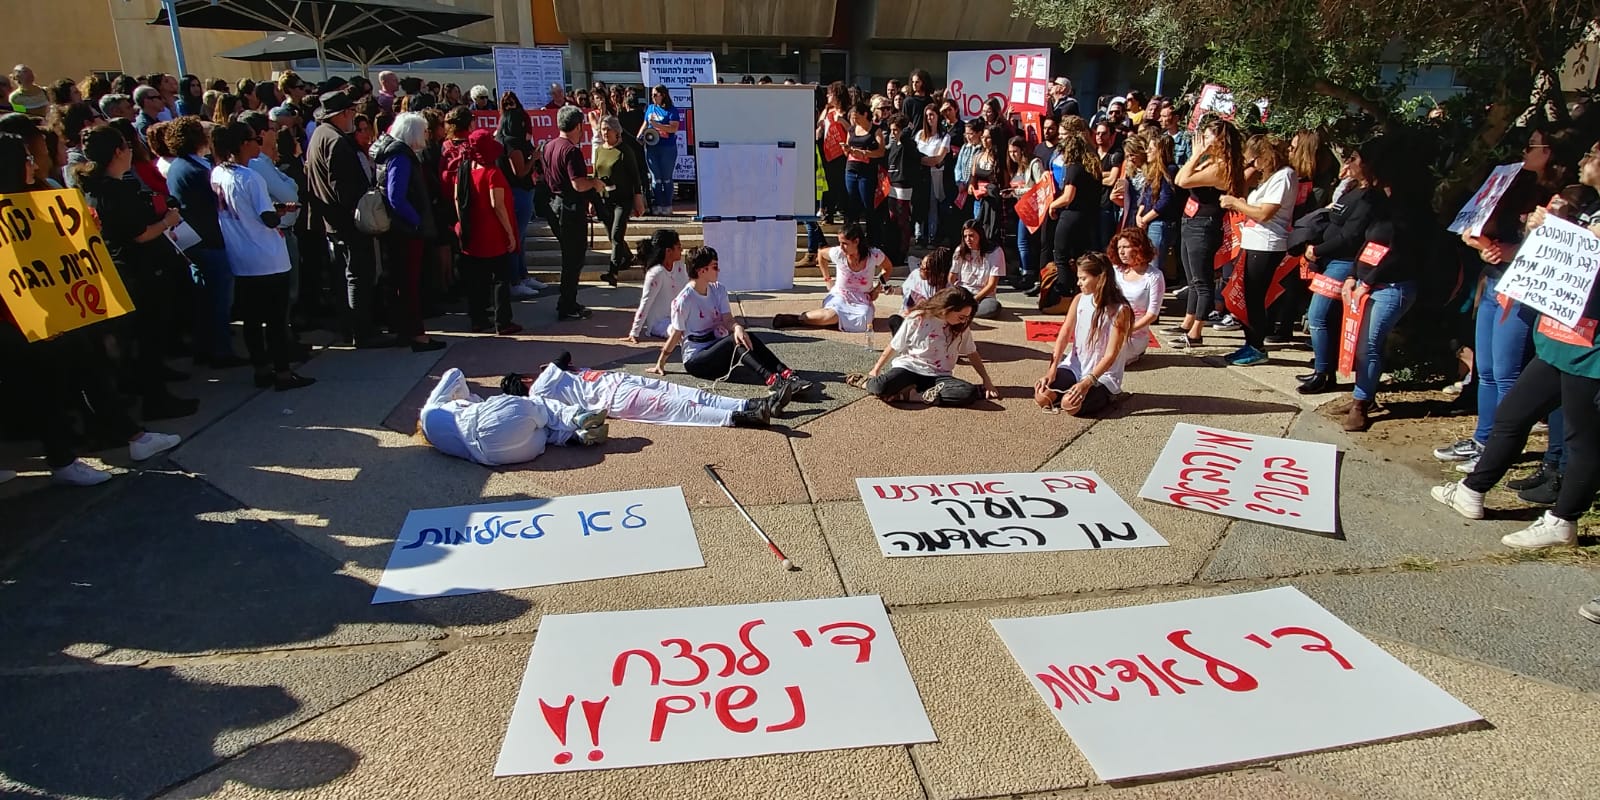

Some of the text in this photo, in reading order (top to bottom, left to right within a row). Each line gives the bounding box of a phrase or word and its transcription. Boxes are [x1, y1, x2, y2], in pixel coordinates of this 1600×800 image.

[693, 57, 714, 65] לימות
[0, 198, 35, 248] יכול
[1041, 475, 1098, 494] דם
[402, 504, 647, 549] לא לאלימות
[1078, 522, 1138, 548] מן
[611, 619, 876, 686] די לרצח
[1035, 626, 1355, 710] די לאדישות
[650, 684, 806, 742] נשים
